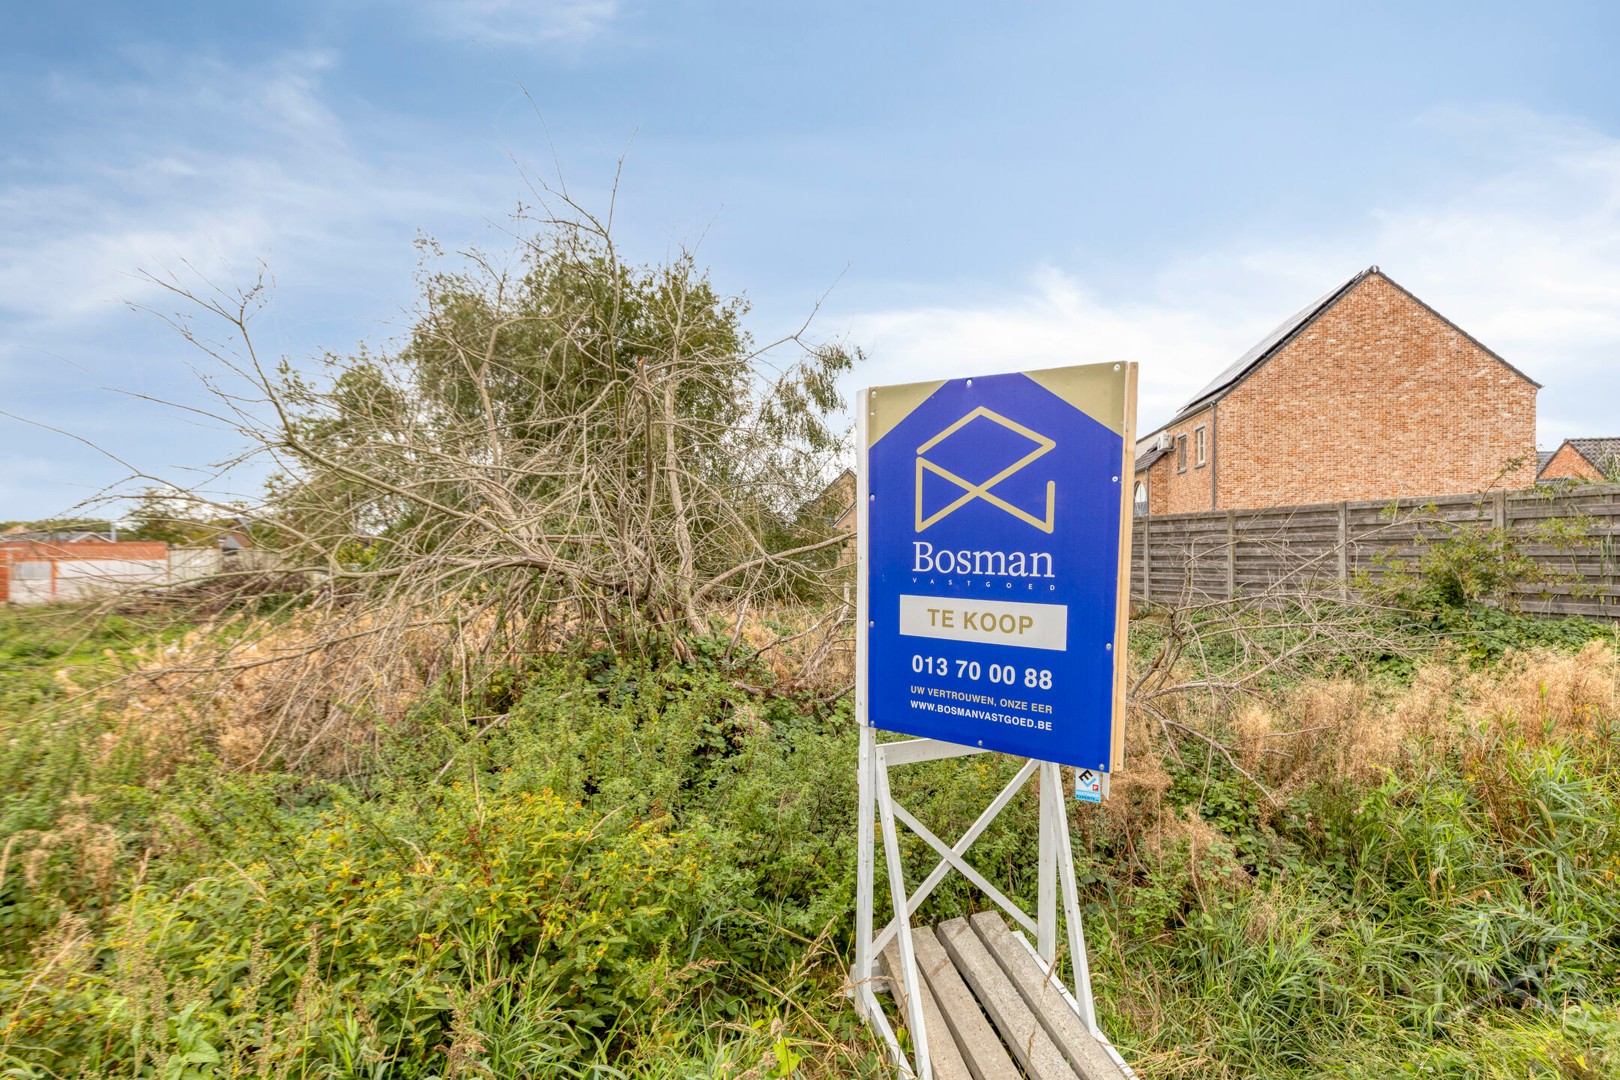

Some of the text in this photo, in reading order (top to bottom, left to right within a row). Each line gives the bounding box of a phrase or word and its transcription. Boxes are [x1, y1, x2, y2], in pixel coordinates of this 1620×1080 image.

[912, 541, 1055, 578] Bosman
[912, 577, 1055, 591] VASTGOED
[927, 608, 1033, 635] TE KOOP
[911, 654, 1053, 690] 013 70 00 88
[910, 685, 1053, 714] UW VERTROUWEN, ONZE EER
[910, 700, 1052, 731] WWW.BOSMANVASTGOED.BE
